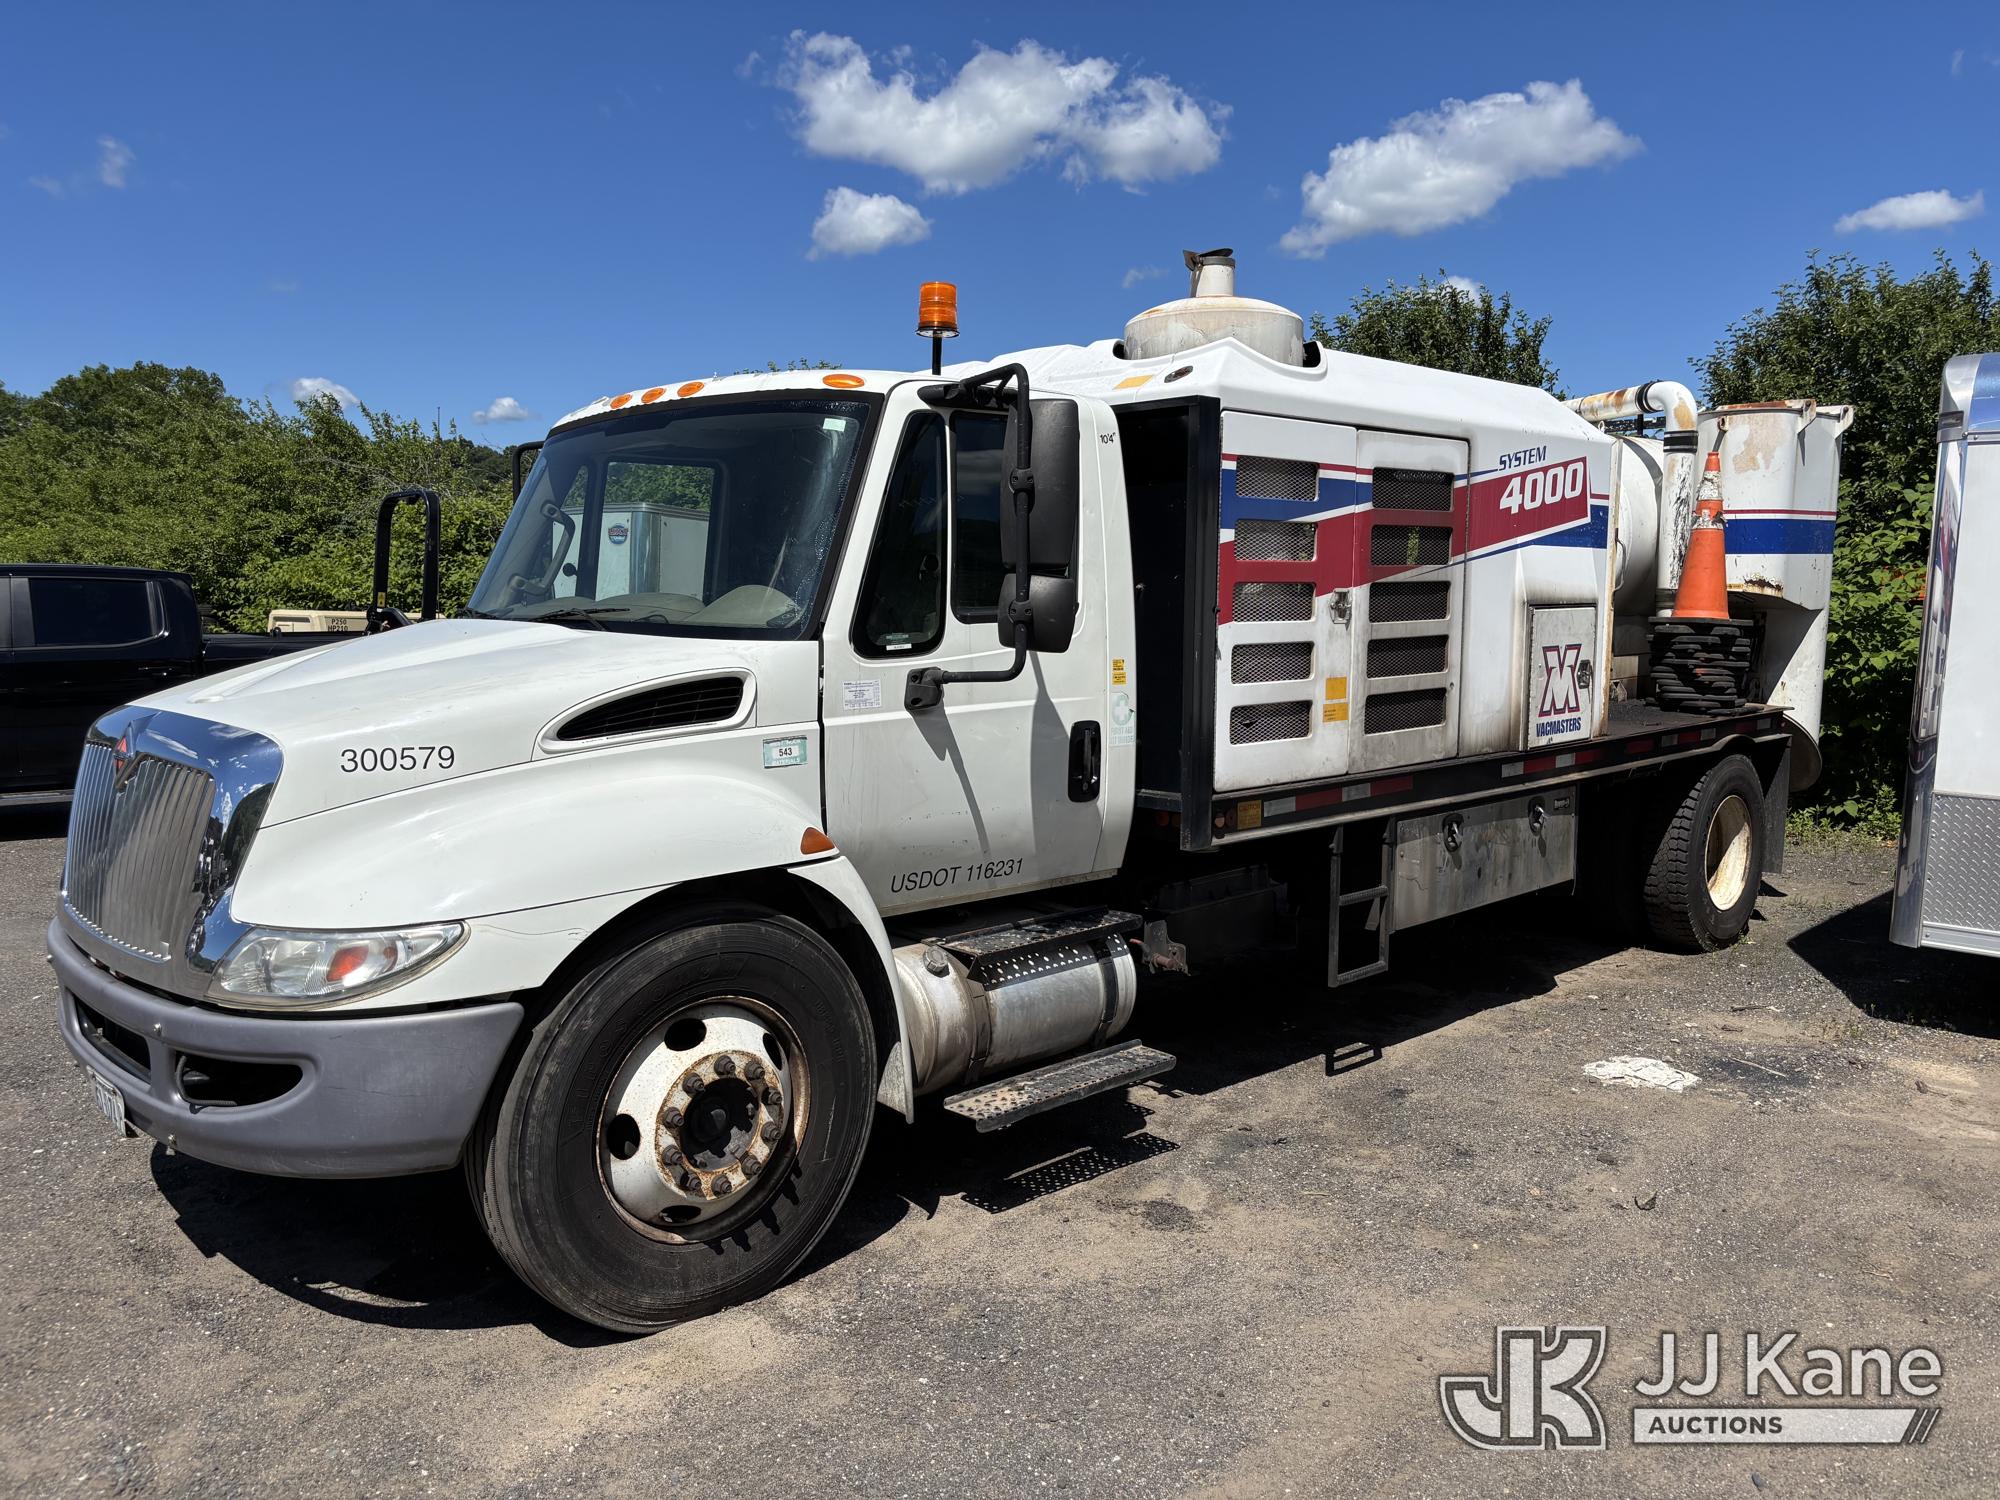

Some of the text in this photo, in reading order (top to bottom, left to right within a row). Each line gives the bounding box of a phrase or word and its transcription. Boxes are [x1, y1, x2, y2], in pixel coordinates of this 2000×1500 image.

[1499, 445, 1547, 471] SYSTEM
[1500, 461, 1584, 515] 4000
[1536, 717, 1581, 737] VACMASTERS
[340, 745, 455, 773] 300579
[778, 747, 793, 757] 543
[891, 858, 1023, 893] USDOT 116231
